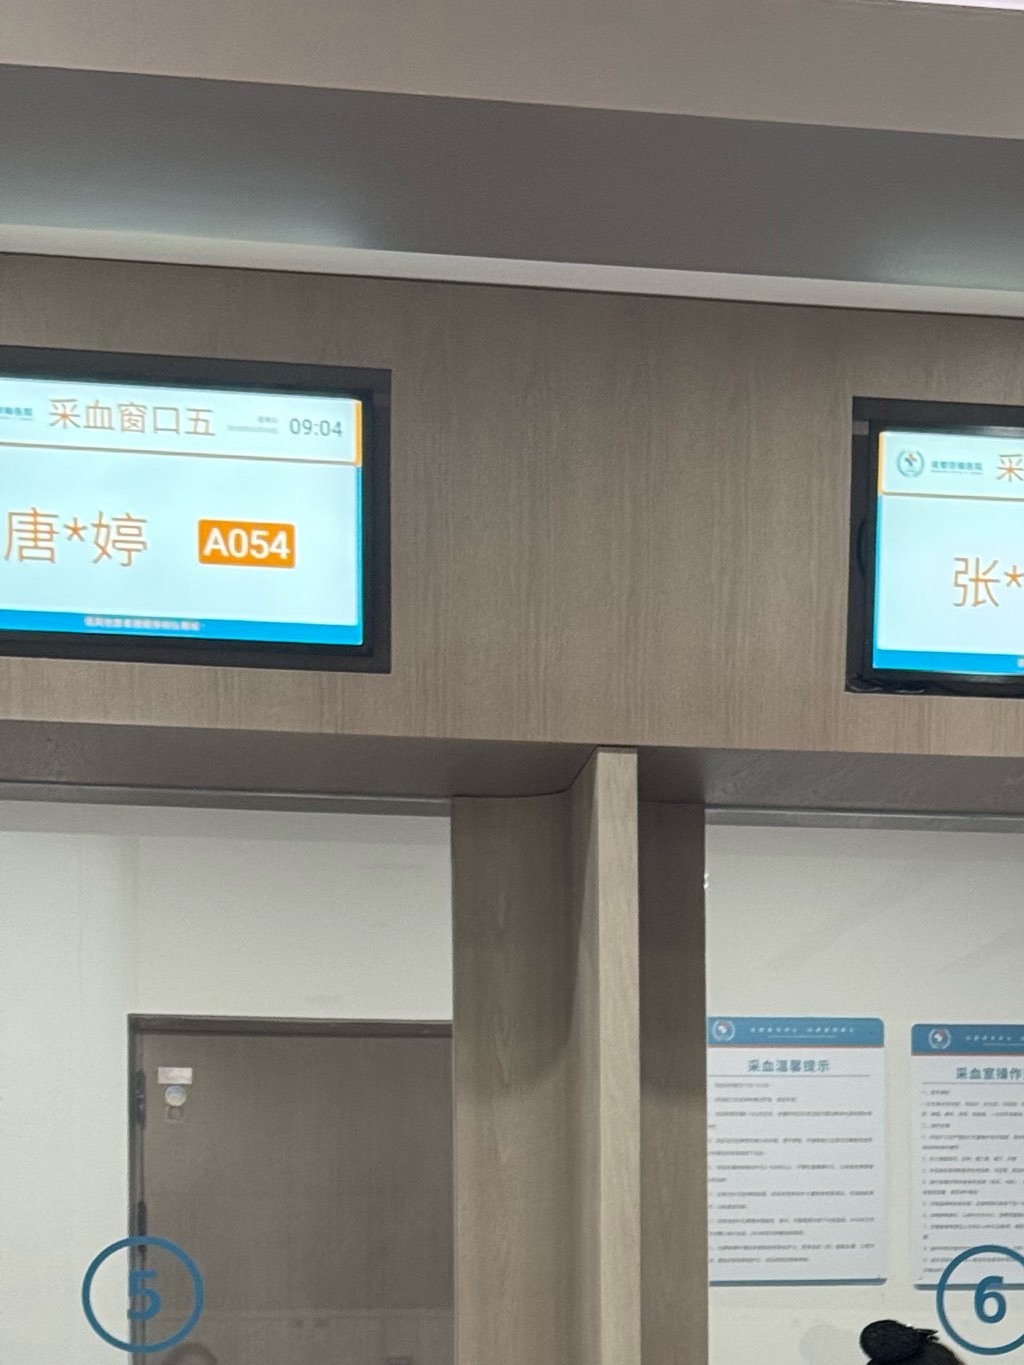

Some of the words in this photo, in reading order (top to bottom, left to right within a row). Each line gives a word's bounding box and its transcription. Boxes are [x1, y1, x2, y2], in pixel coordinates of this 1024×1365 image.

[49, 397, 216, 437] 采血窗口五
[289, 417, 343, 438] 09:04
[203, 528, 291, 560] A054
[747, 1059, 831, 1073] 采血温馨提示
[127, 1269, 162, 1322] 5
[974, 1275, 1007, 1324] 6
